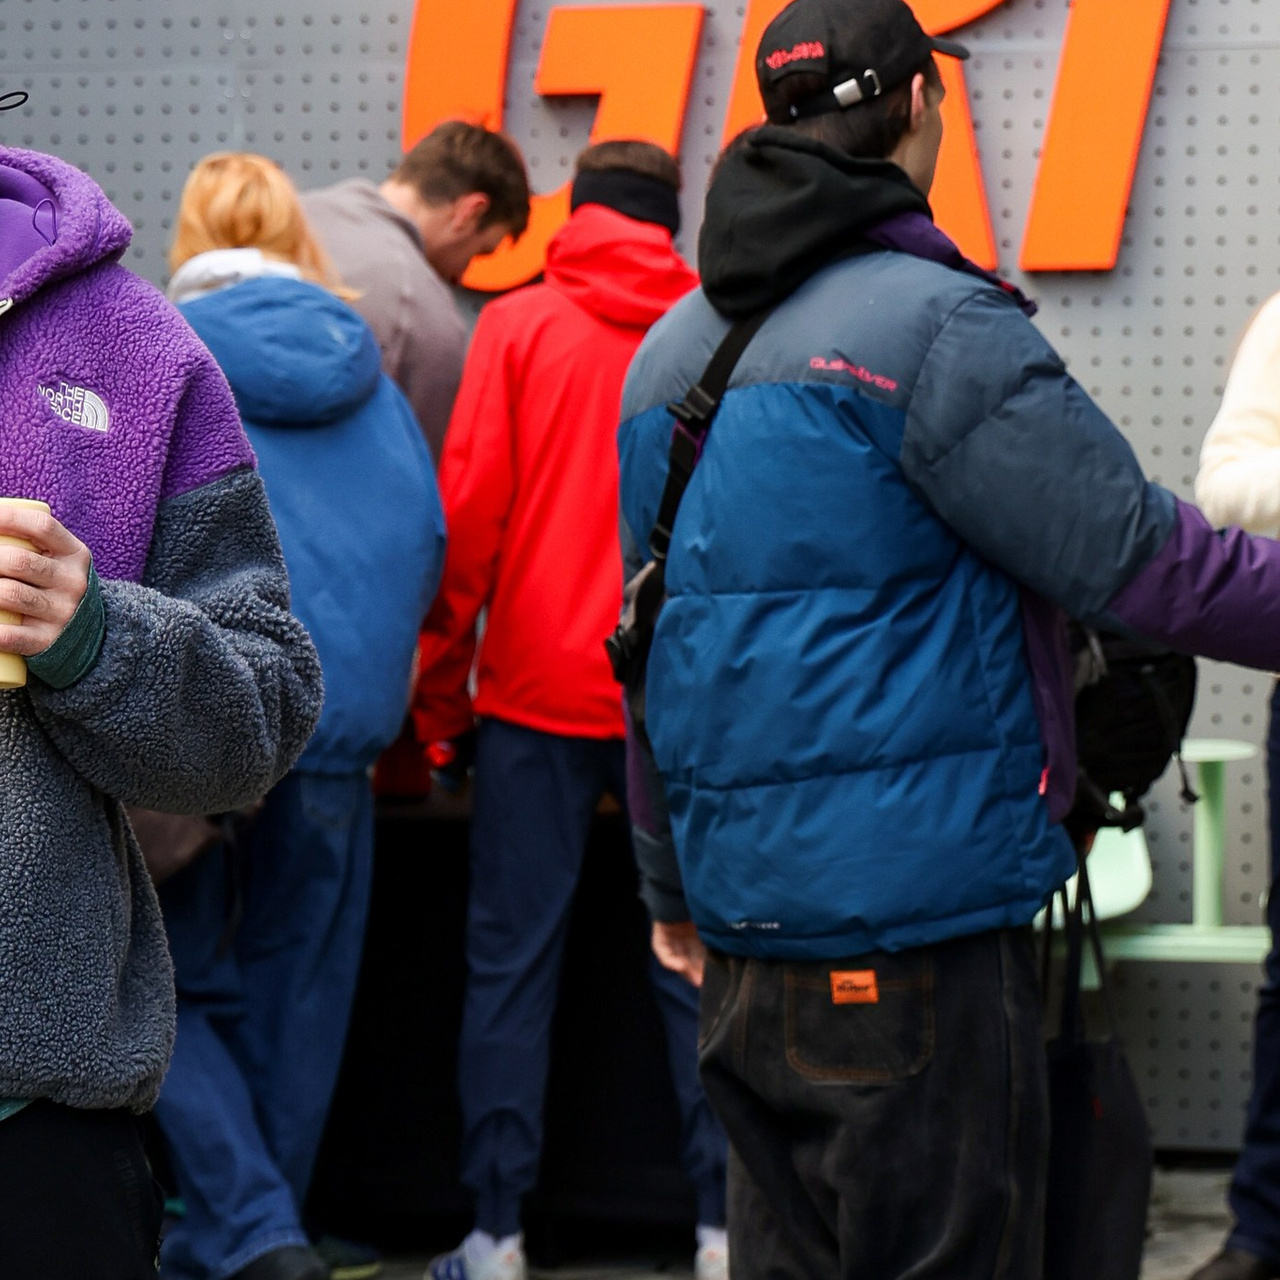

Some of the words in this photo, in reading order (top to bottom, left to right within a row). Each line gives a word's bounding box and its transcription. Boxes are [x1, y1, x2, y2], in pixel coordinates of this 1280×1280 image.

[38, 384, 83, 412] NORTH
[60, 381, 85, 400] THE
[50, 401, 82, 425] FACE
